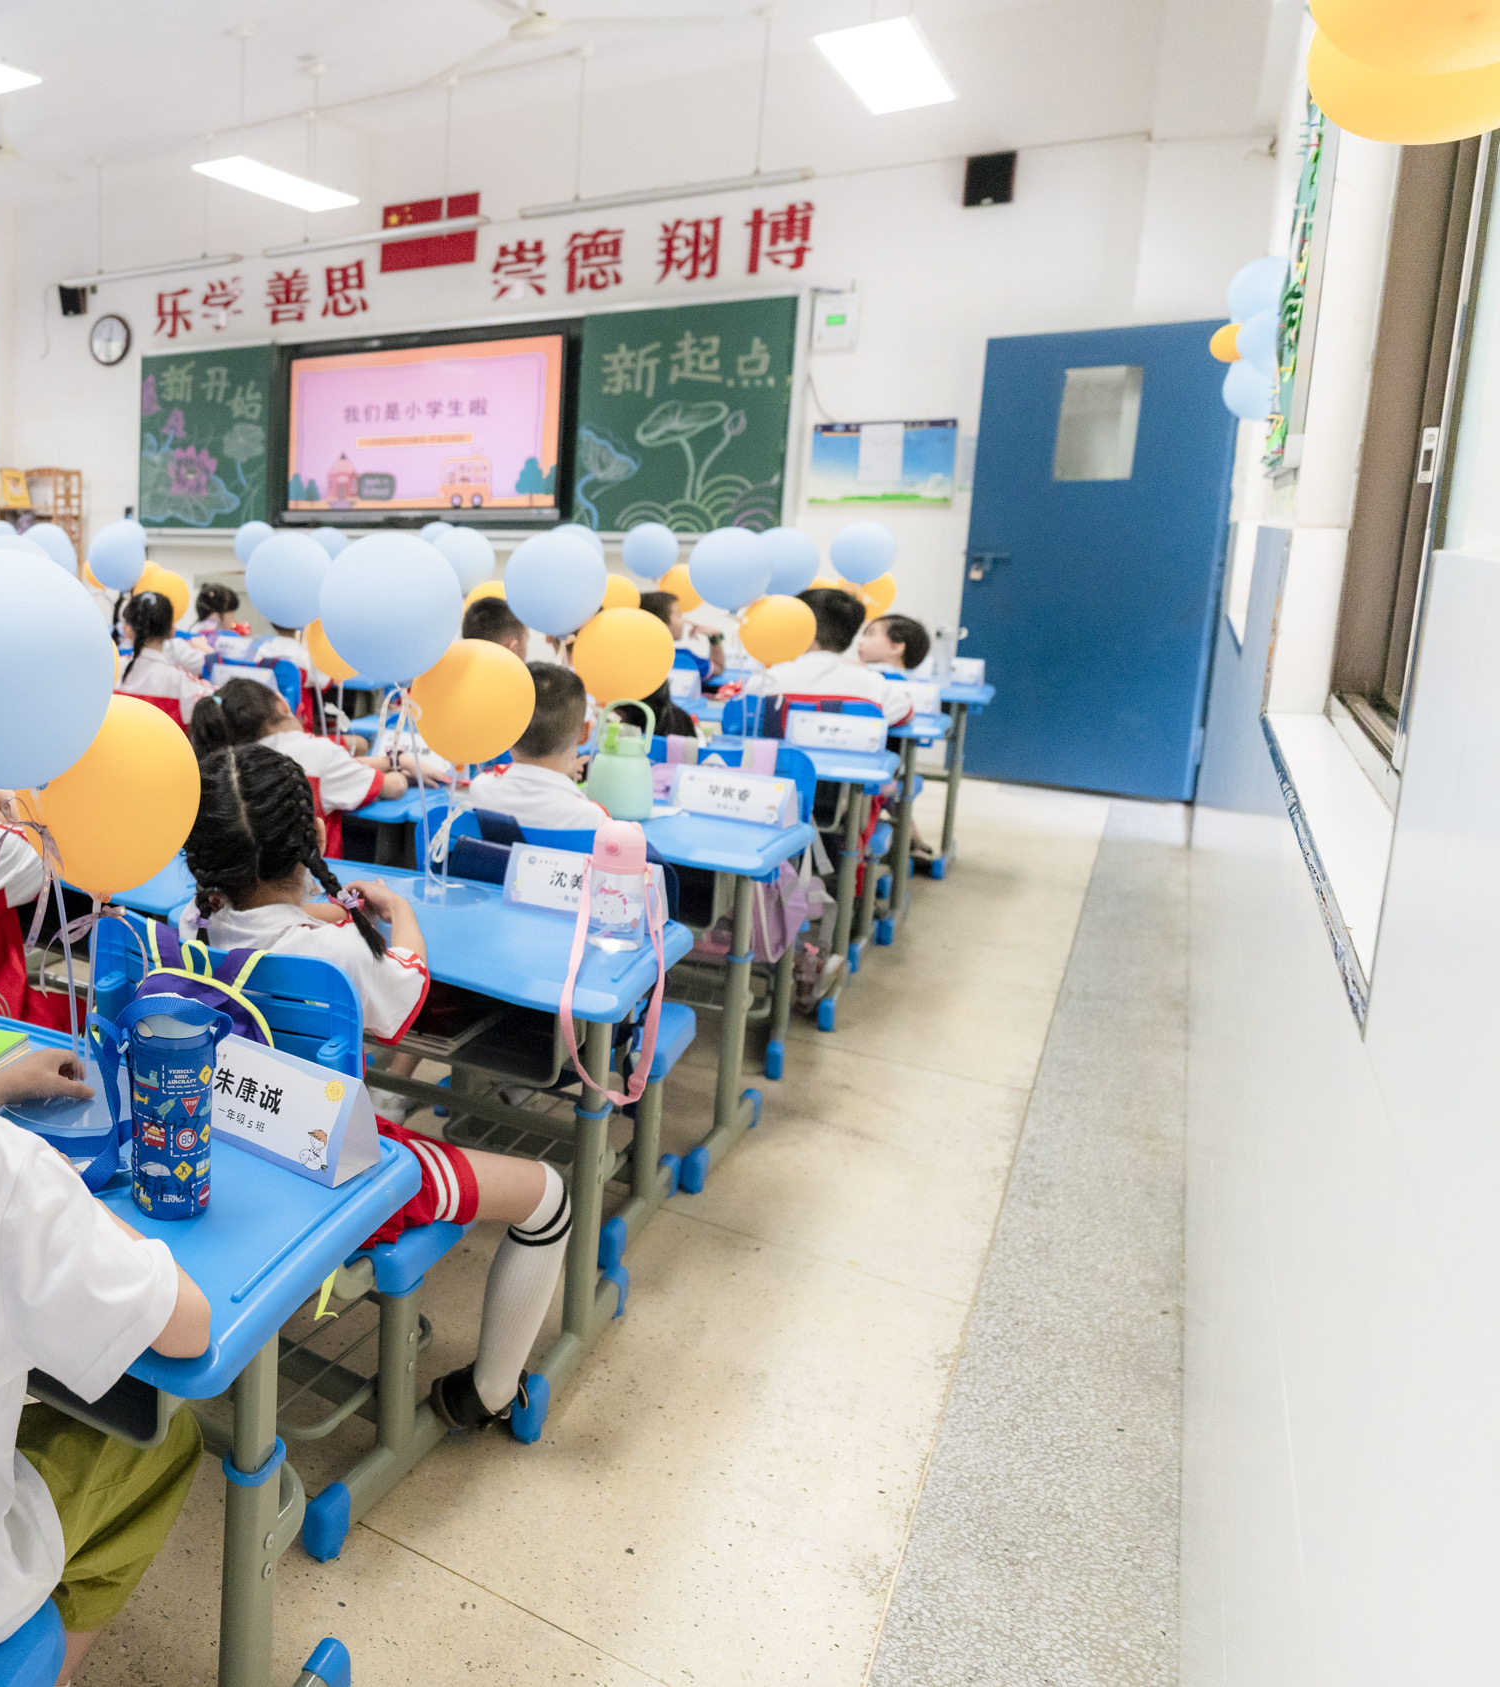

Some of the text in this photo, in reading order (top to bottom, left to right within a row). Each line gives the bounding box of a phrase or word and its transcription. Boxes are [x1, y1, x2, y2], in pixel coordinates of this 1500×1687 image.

[493, 201, 816, 300] 崇德翔博
[154, 259, 369, 339] 乐学善思
[160, 361, 263, 420] 新开始
[602, 331, 776, 398] 新起点
[344, 397, 488, 424] 我们是小学生啦
[214, 1067, 283, 1115] 朱康诚
[181, 1134, 193, 1145] 80
